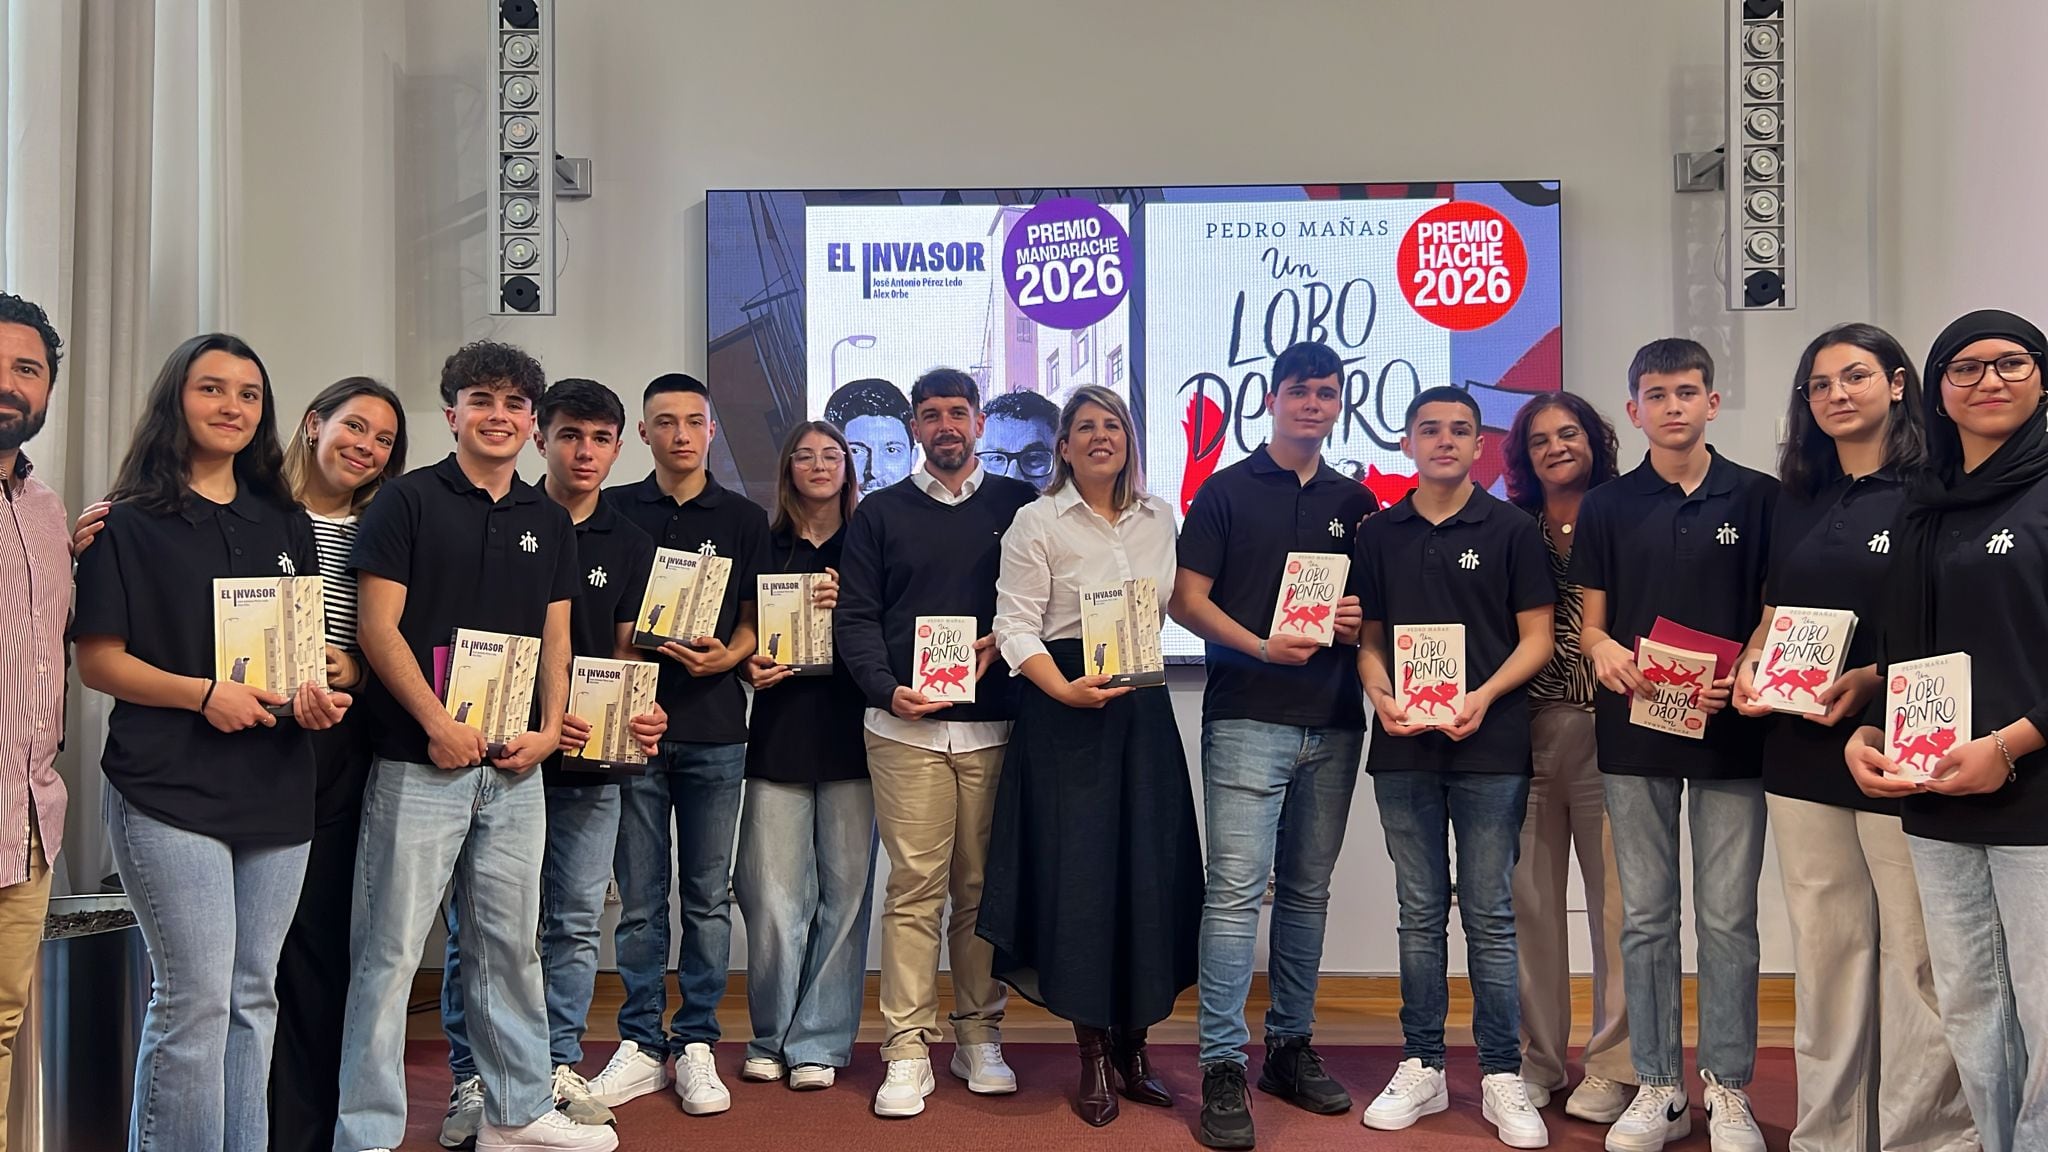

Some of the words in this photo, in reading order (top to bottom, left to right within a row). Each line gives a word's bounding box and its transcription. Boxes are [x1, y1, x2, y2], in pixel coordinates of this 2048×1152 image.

[1026, 217, 1102, 245] PREMIO
[1206, 221, 1287, 239] PEDRO
[1299, 216, 1390, 238] MAÑAS
[1417, 219, 1504, 246] PREMIO
[1015, 236, 1120, 266] MANDARACHE
[1417, 241, 1504, 270] HACHE
[827, 242, 856, 273] EL
[862, 241, 987, 300] INVASOR
[1261, 246, 1319, 280] Un
[873, 278, 890, 288] José
[890, 278, 921, 288] Antonio
[922, 277, 944, 287] Pérez
[945, 276, 963, 287] Ledo
[1014, 253, 1125, 308] 2026
[1413, 266, 1512, 308] 2026
[891, 288, 909, 299] Orbe
[1227, 277, 1377, 368] LOBO
[659, 555, 666, 563] EL
[666, 557, 697, 570] INVASOR
[1297, 567, 1330, 583] LOBO
[221, 589, 231, 599] EL
[233, 588, 276, 607] INVASOR
[1084, 593, 1092, 601] EL
[930, 630, 961, 647] LOBO
[1787, 624, 1829, 642] LOBO
[461, 639, 469, 649] EL
[468, 641, 504, 657] INVASOR
[1413, 639, 1447, 660] LOBO
[577, 668, 586, 677] EL
[586, 669, 621, 684] INVASOR
[1906, 675, 1945, 704] LOBO
[1648, 703, 1688, 722] LOBO
